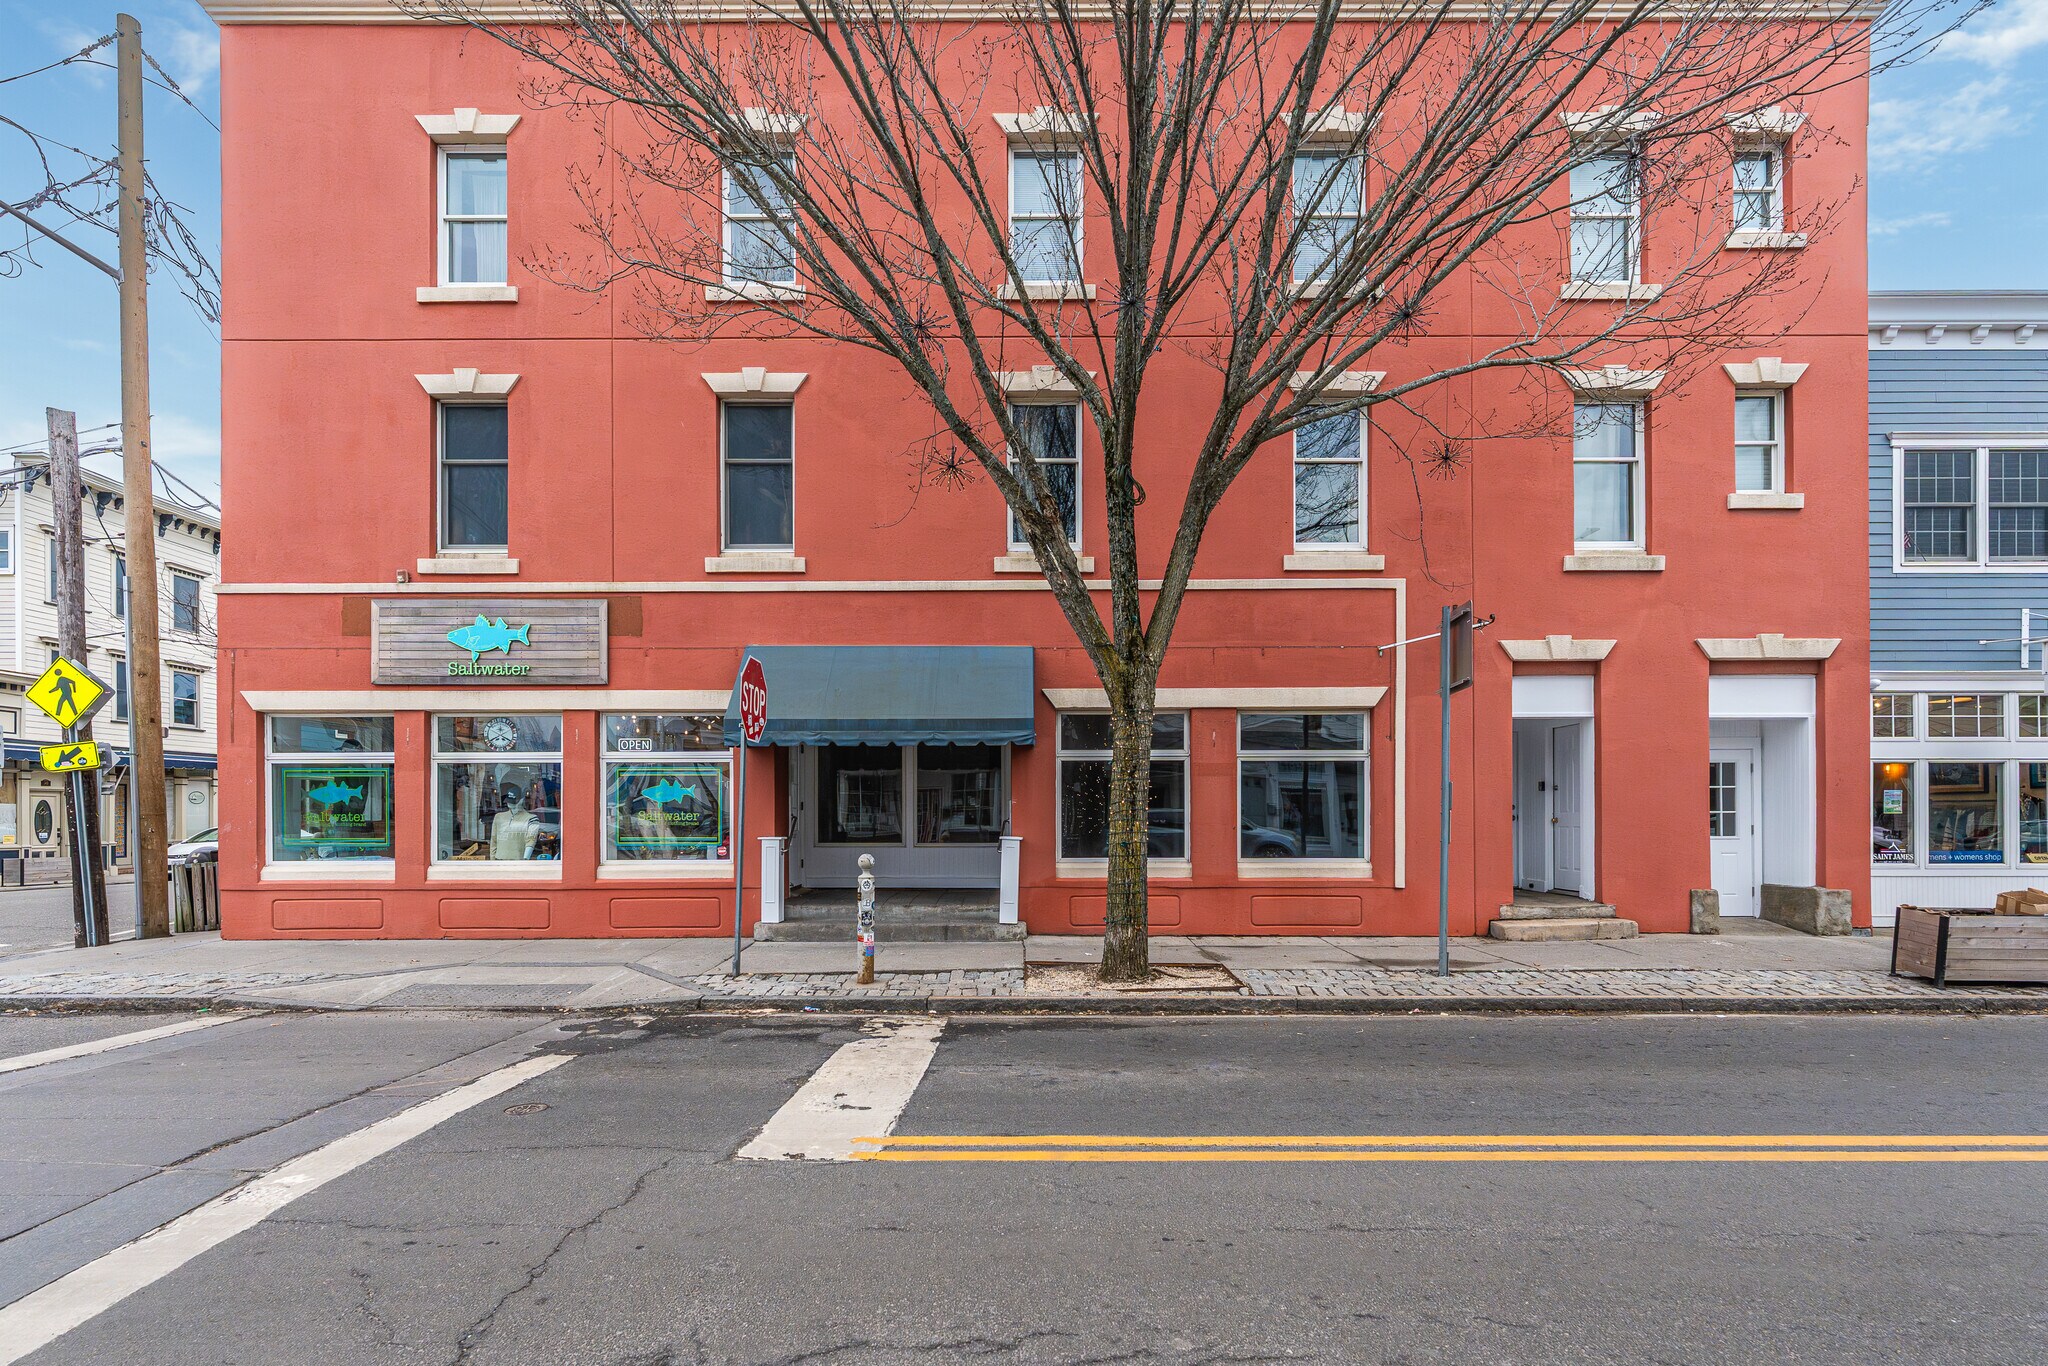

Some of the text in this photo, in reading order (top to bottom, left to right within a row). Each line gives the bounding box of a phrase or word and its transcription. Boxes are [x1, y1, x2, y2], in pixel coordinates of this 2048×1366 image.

[448, 662, 530, 676] Saltwater
[742, 681, 766, 717] STOP
[620, 740, 650, 750] OPEN
[638, 810, 700, 821] Saltwater
[1984, 853, 2002, 863] shop
